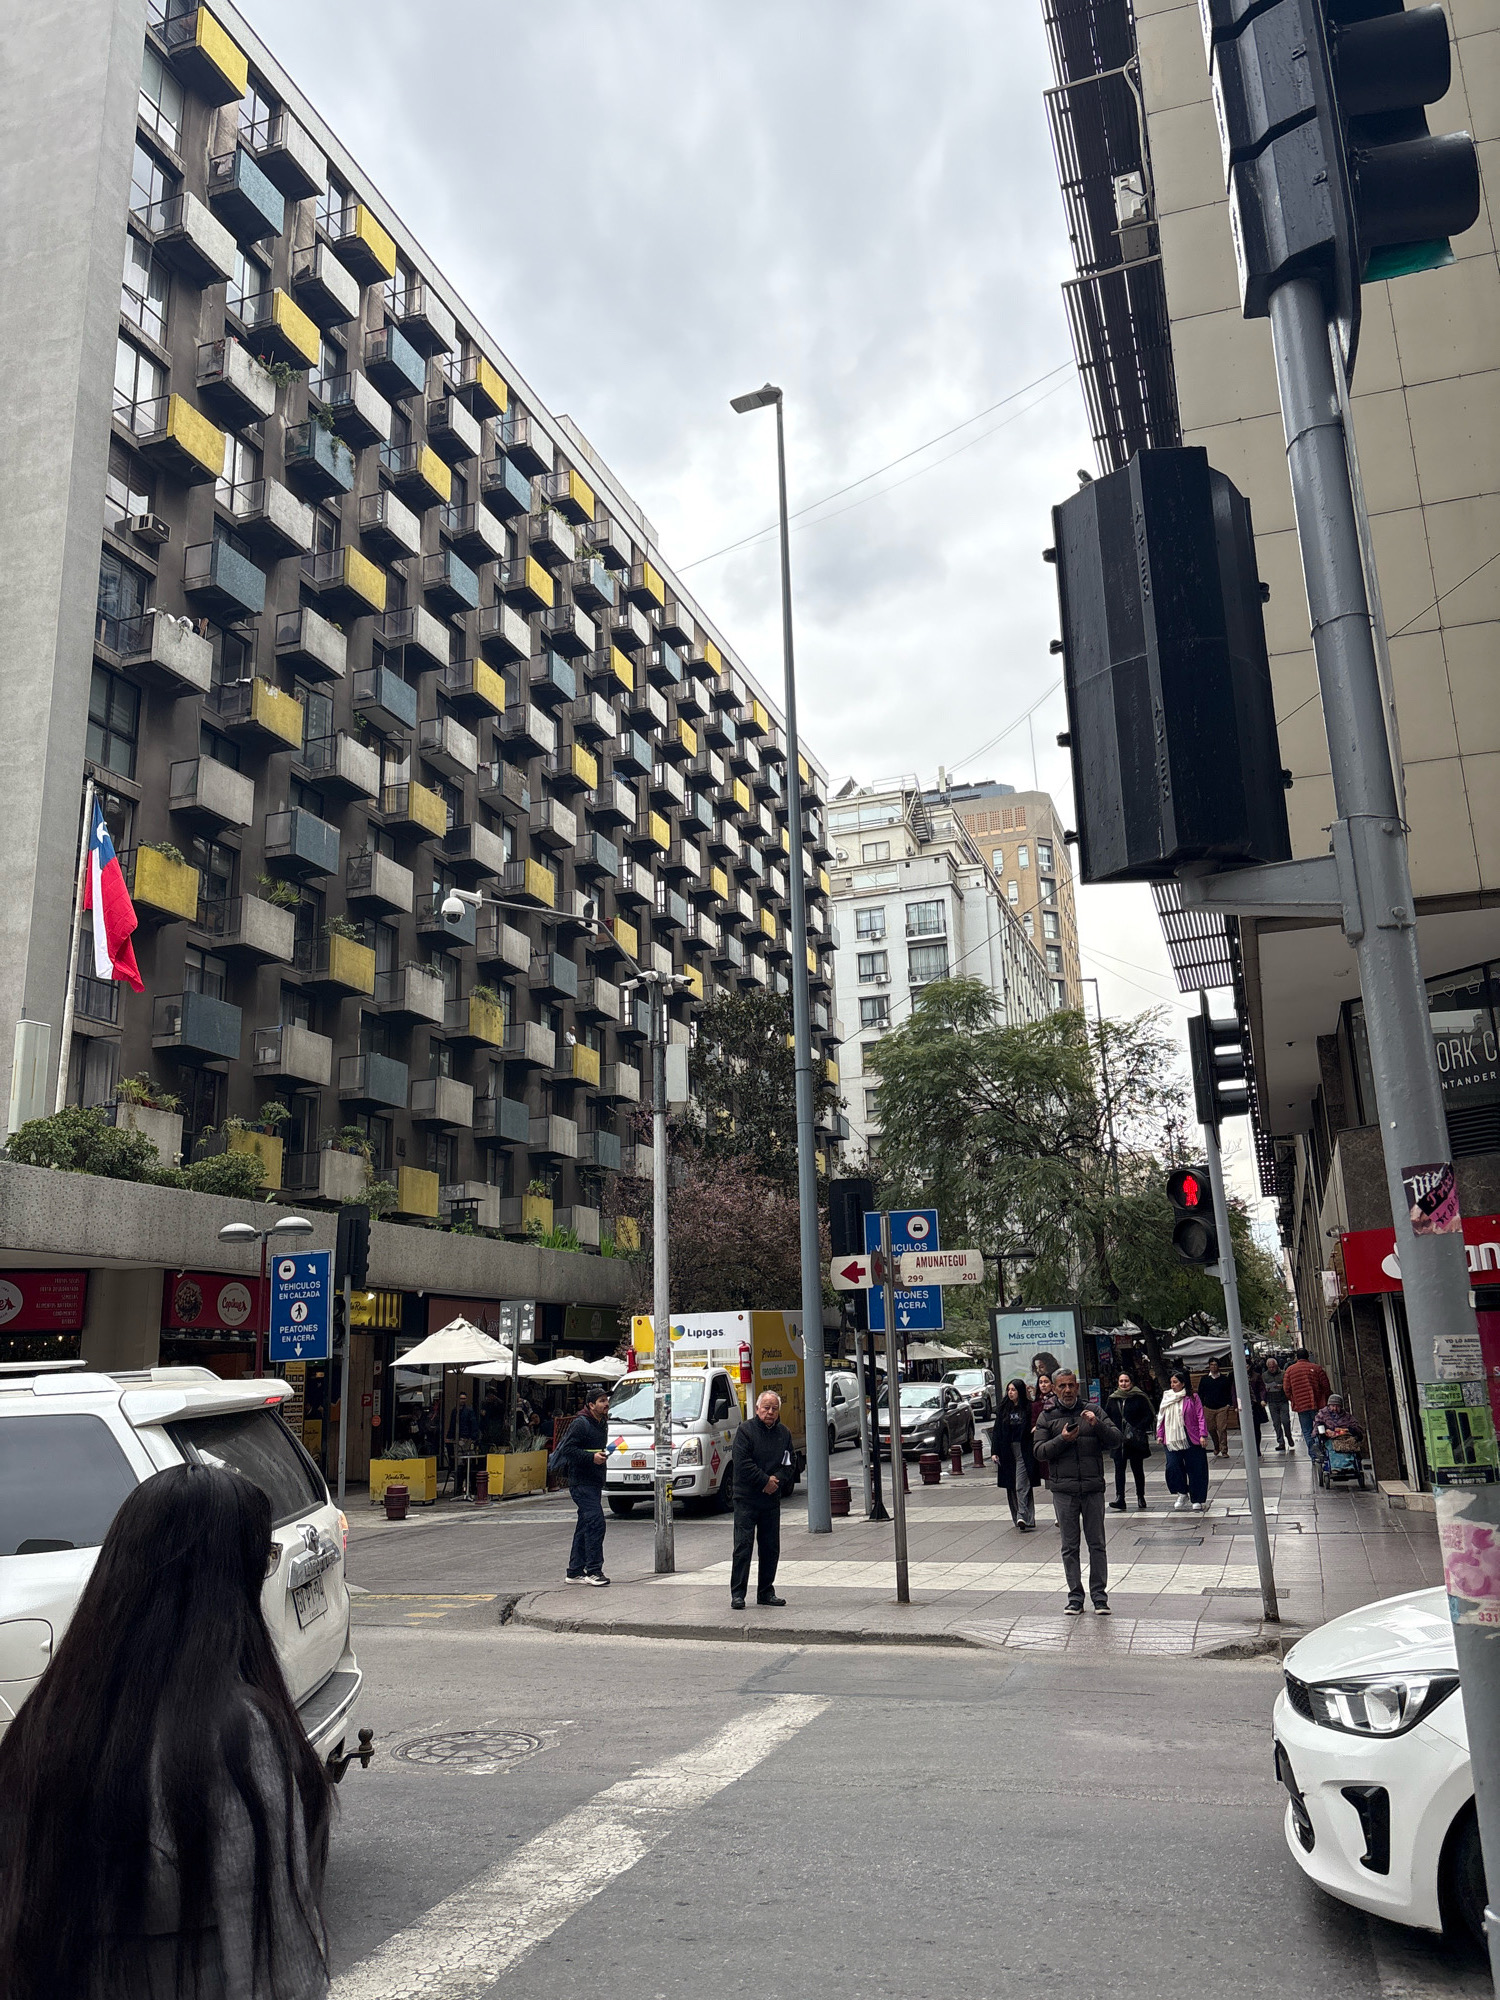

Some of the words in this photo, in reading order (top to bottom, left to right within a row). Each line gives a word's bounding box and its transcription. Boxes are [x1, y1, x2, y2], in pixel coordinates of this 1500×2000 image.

[1436, 1034, 1478, 1073] ORK
[1441, 1071, 1497, 1090] NTANDER
[874, 1242, 928, 1252] VICULOS
[915, 1254, 967, 1269] AMUNATEGUI
[907, 1275, 924, 1283] 299
[962, 1272, 977, 1281] 201
[279, 1281, 321, 1291] VEHICULOS
[289, 1290, 321, 1299] CALZADA
[880, 1290, 929, 1299] PATONES
[897, 1301, 927, 1309] ACERA
[1021, 1318, 1051, 1327] Alflorex
[279, 1324, 319, 1334] PEATONES
[292, 1334, 316, 1342] ACERA
[1008, 1332, 1024, 1340] Más
[1025, 1331, 1047, 1339] cerca
[1048, 1330, 1058, 1338] de
[1059, 1330, 1066, 1338] ti
